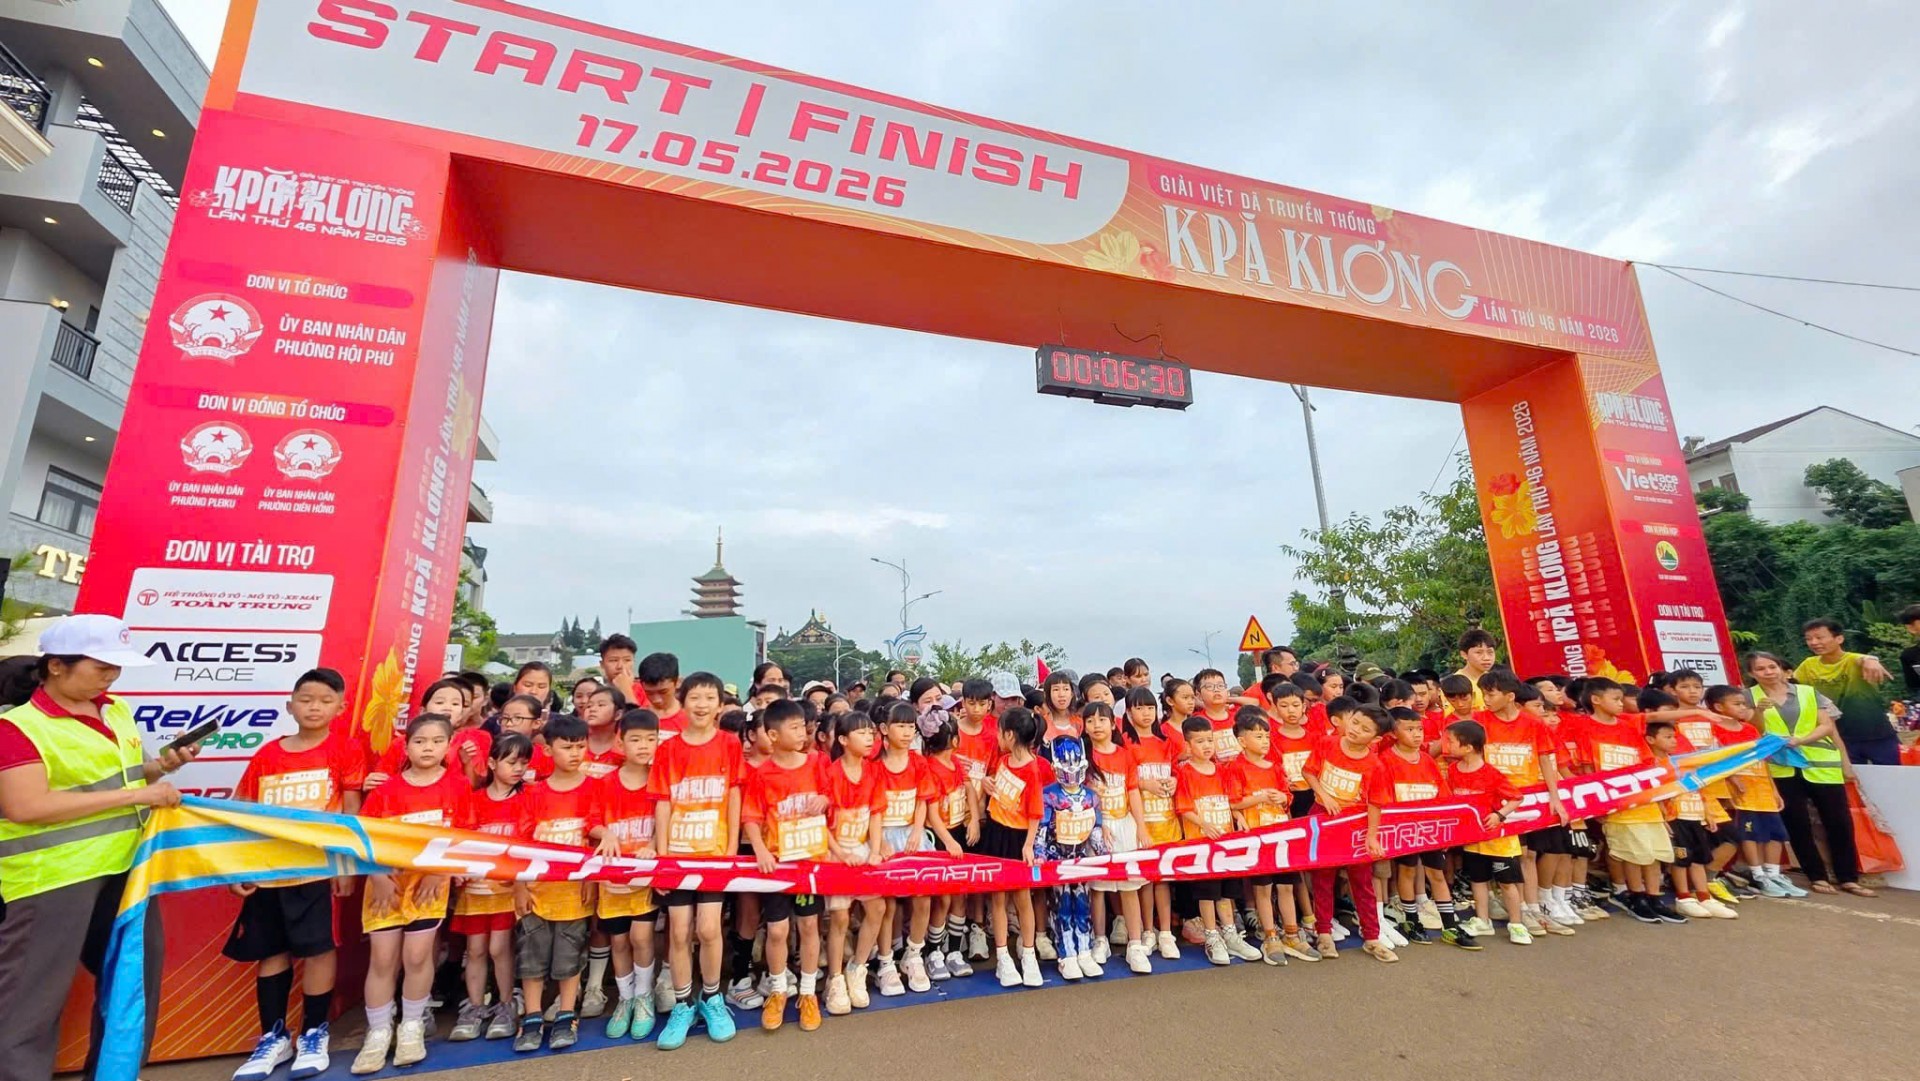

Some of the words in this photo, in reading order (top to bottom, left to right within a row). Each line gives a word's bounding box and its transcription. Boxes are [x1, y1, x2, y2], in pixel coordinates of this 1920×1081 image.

[307, 0, 713, 116] START
[788, 100, 1083, 200] FINISH
[576, 113, 907, 208] 17.05.2026
[1159, 173, 1194, 199] GIẢI
[1199, 182, 1234, 208] VIỆT
[1240, 190, 1262, 213] DÃ
[1266, 196, 1324, 225] TRUYỀN
[1328, 208, 1377, 236] THỐNG
[293, 222, 317, 233] 46
[320, 224, 361, 240] NĂM
[363, 232, 408, 247] 2026
[246, 273, 276, 291] ĐƠN
[277, 278, 291, 295] VỊ
[294, 276, 311, 294] TỔ
[312, 282, 349, 301] CHỨC
[1279, 228, 1479, 321] KLƠNG
[279, 313, 299, 333] ỦY
[301, 320, 332, 338] BAN
[335, 321, 374, 344] NHÂN
[377, 327, 407, 347] DÂN
[1538, 314, 1556, 332] 46
[1558, 315, 1586, 338] NĂM
[1587, 322, 1620, 344] 2026
[274, 338, 335, 361] PHƯỜNG
[337, 344, 363, 366] HỘI
[364, 349, 395, 367] PHÚ
[1052, 350, 1185, 397] 00:06:30
[198, 394, 229, 413] ĐƠN
[231, 398, 246, 416] VỊ
[247, 395, 286, 416] ĐỒNG
[289, 398, 308, 418] TỔ
[309, 404, 346, 422] CHỨC
[1511, 400, 1535, 438] 2026
[1519, 439, 1543, 468] NĂM
[1526, 464, 1544, 486] 46
[422, 454, 448, 553] KLƠNG
[1530, 484, 1552, 514] THỨ
[1531, 509, 1558, 541] LẦN
[165, 539, 211, 562] ĐƠN
[216, 542, 235, 569] VỊ
[241, 539, 271, 565] TÀI
[276, 544, 316, 570] TRỢ
[410, 553, 434, 617] KPĂ
[1535, 540, 1571, 602] KLƠNG
[171, 596, 238, 609] TOÀN
[239, 600, 313, 611] TRUNG
[1545, 601, 1580, 643] KPĂ
[401, 622, 423, 695] THỐNG
[174, 667, 256, 682] RACE
[199, 732, 264, 750] PRO
[263, 782, 320, 806] 61658
